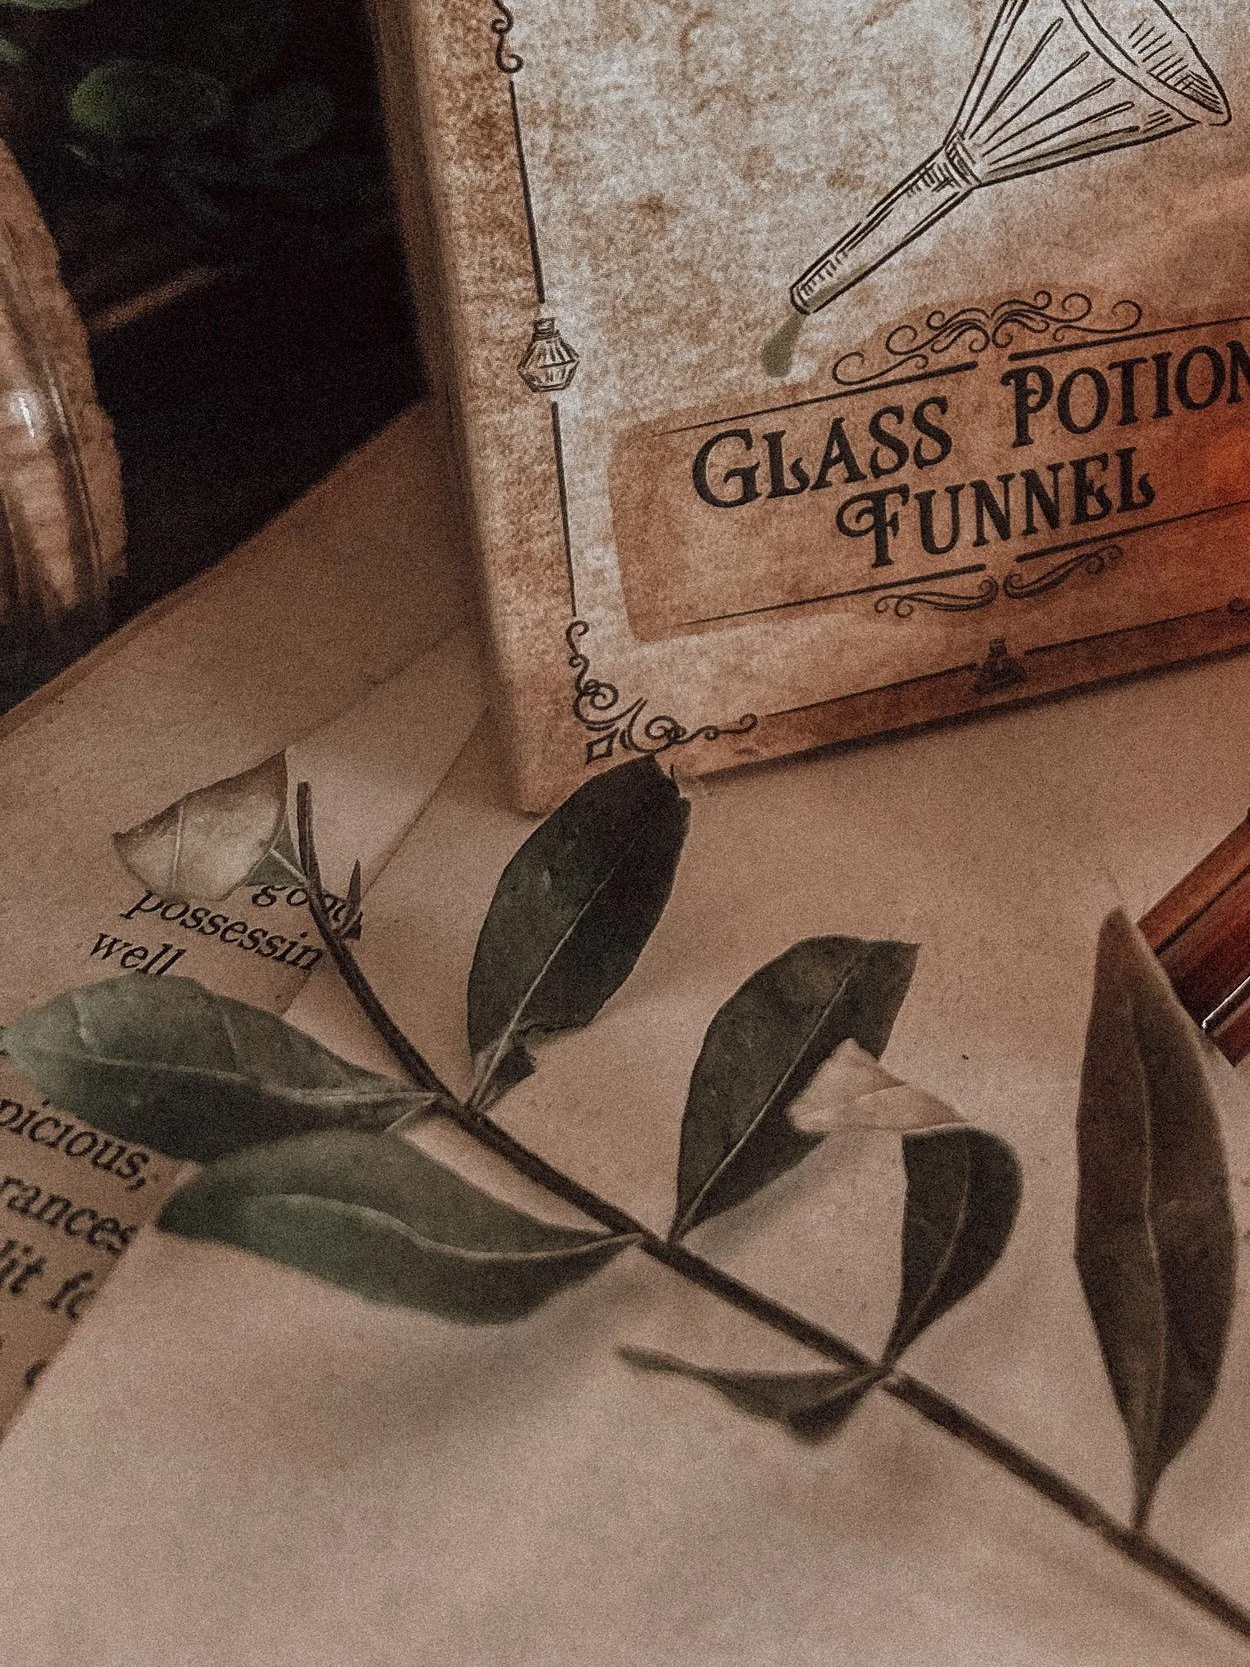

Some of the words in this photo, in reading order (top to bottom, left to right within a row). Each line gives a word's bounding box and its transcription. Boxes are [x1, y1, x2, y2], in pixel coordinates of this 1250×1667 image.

[691, 395, 953, 509] GLASS
[835, 446, 1156, 570] FUNNEL
[90, 932, 187, 976] well
[118, 889, 324, 971] possessin
